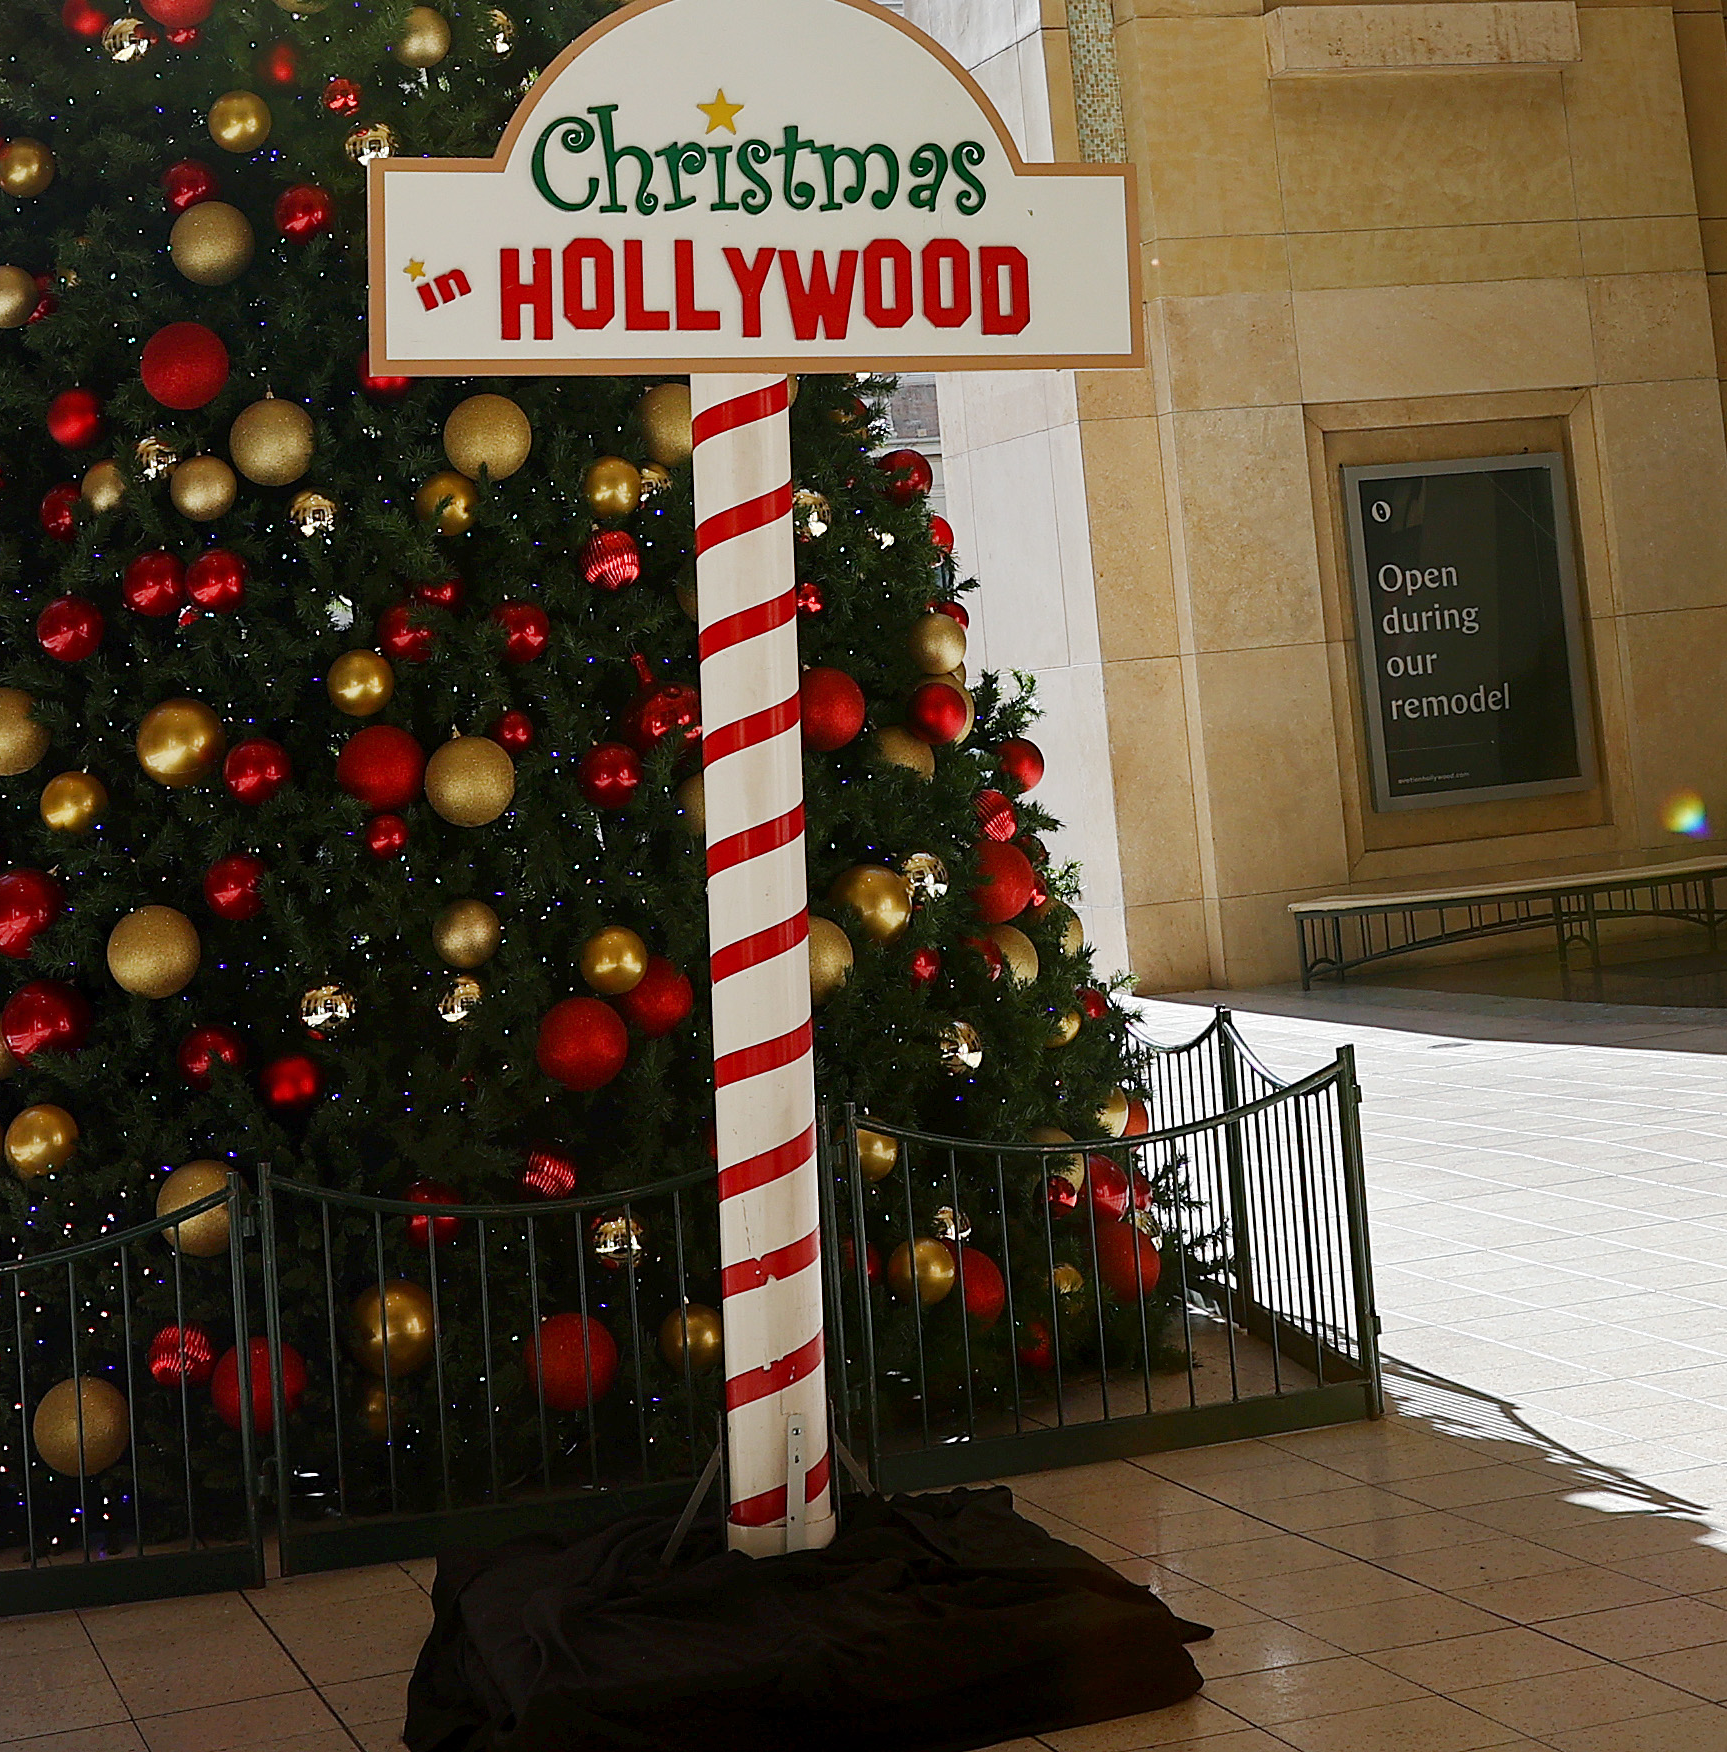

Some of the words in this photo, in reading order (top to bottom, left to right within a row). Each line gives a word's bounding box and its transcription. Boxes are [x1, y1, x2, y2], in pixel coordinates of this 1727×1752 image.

[531, 104, 989, 217] Christmas
[415, 266, 472, 312] in
[499, 237, 1032, 342] HOLLYWOOD
[1377, 563, 1458, 596] Open
[1381, 603, 1480, 635] during
[1386, 651, 1438, 677] our
[1390, 682, 1511, 720] remodel
